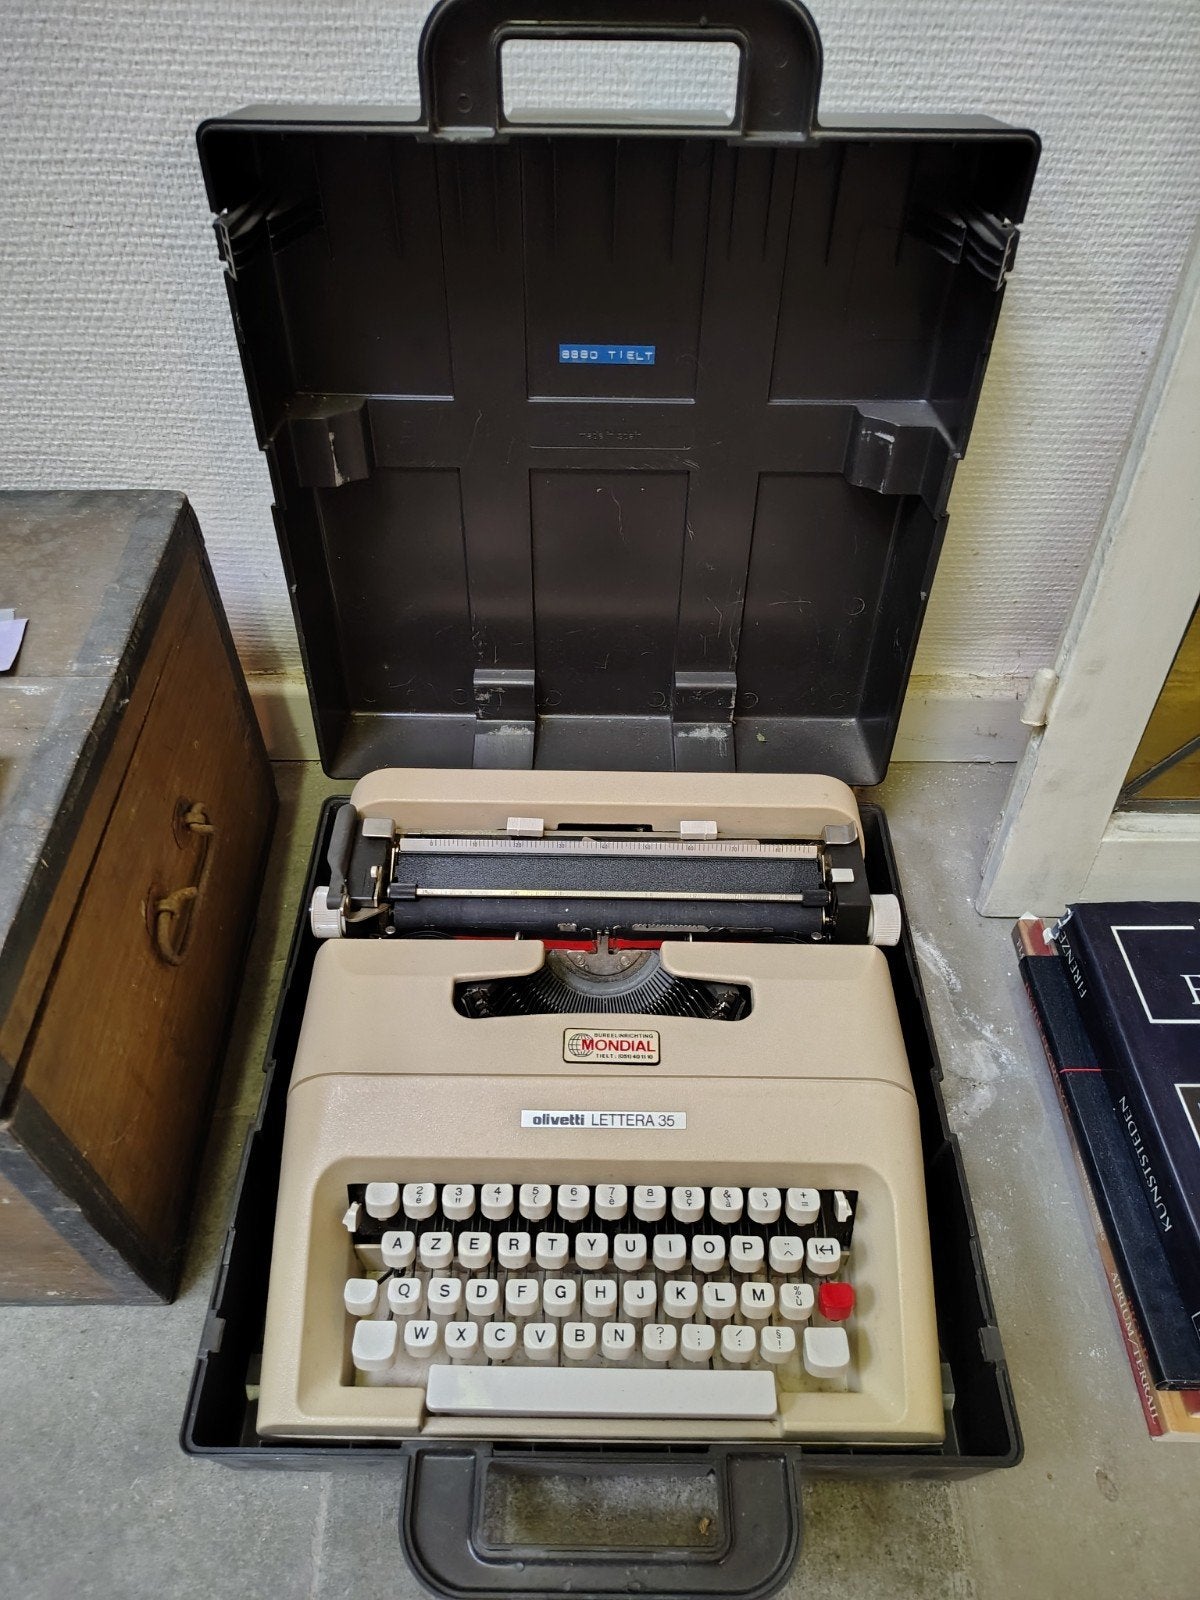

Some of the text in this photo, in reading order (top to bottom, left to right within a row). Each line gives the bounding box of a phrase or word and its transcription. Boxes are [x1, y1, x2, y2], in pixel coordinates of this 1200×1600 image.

[607, 350, 653, 361] TIELT
[1057, 930, 1087, 999] FIRENZE
[582, 1039, 656, 1052] MONDIAL
[532, 1113, 675, 1127] olivetti LETTERA 35
[1118, 1096, 1173, 1233] KUNSTSTEDEN
[415, 1185, 424, 1195] 2
[454, 1186, 464, 1197] 3
[493, 1186, 502, 1196] 4
[531, 1186, 541, 1196] 5
[569, 1186, 578, 1197] 6
[608, 1186, 616, 1196] 7
[646, 1188, 655, 1197] 8
[684, 1189, 693, 1199] 9
[391, 1236, 403, 1250] A
[429, 1237, 442, 1251] Z
[468, 1237, 481, 1251] E
[508, 1237, 520, 1251] R
[547, 1237, 558, 1251] T
[586, 1238, 598, 1252] Y
[624, 1239, 637, 1253] U
[702, 1240, 716, 1254] O
[741, 1241, 754, 1255] P
[397, 1282, 411, 1299] Q
[439, 1283, 451, 1298] S
[475, 1284, 488, 1299] D
[517, 1284, 528, 1299] F
[554, 1284, 567, 1300] G
[594, 1285, 607, 1299] H
[636, 1286, 645, 1300] J
[675, 1286, 687, 1301] K
[714, 1287, 726, 1302] L
[751, 1287, 766, 1302] M
[413, 1326, 430, 1340] W
[455, 1327, 467, 1342] X
[494, 1327, 506, 1342] C
[534, 1329, 547, 1344] V
[574, 1328, 586, 1343] B
[613, 1328, 625, 1343] N
[656, 1326, 665, 1338] ?
